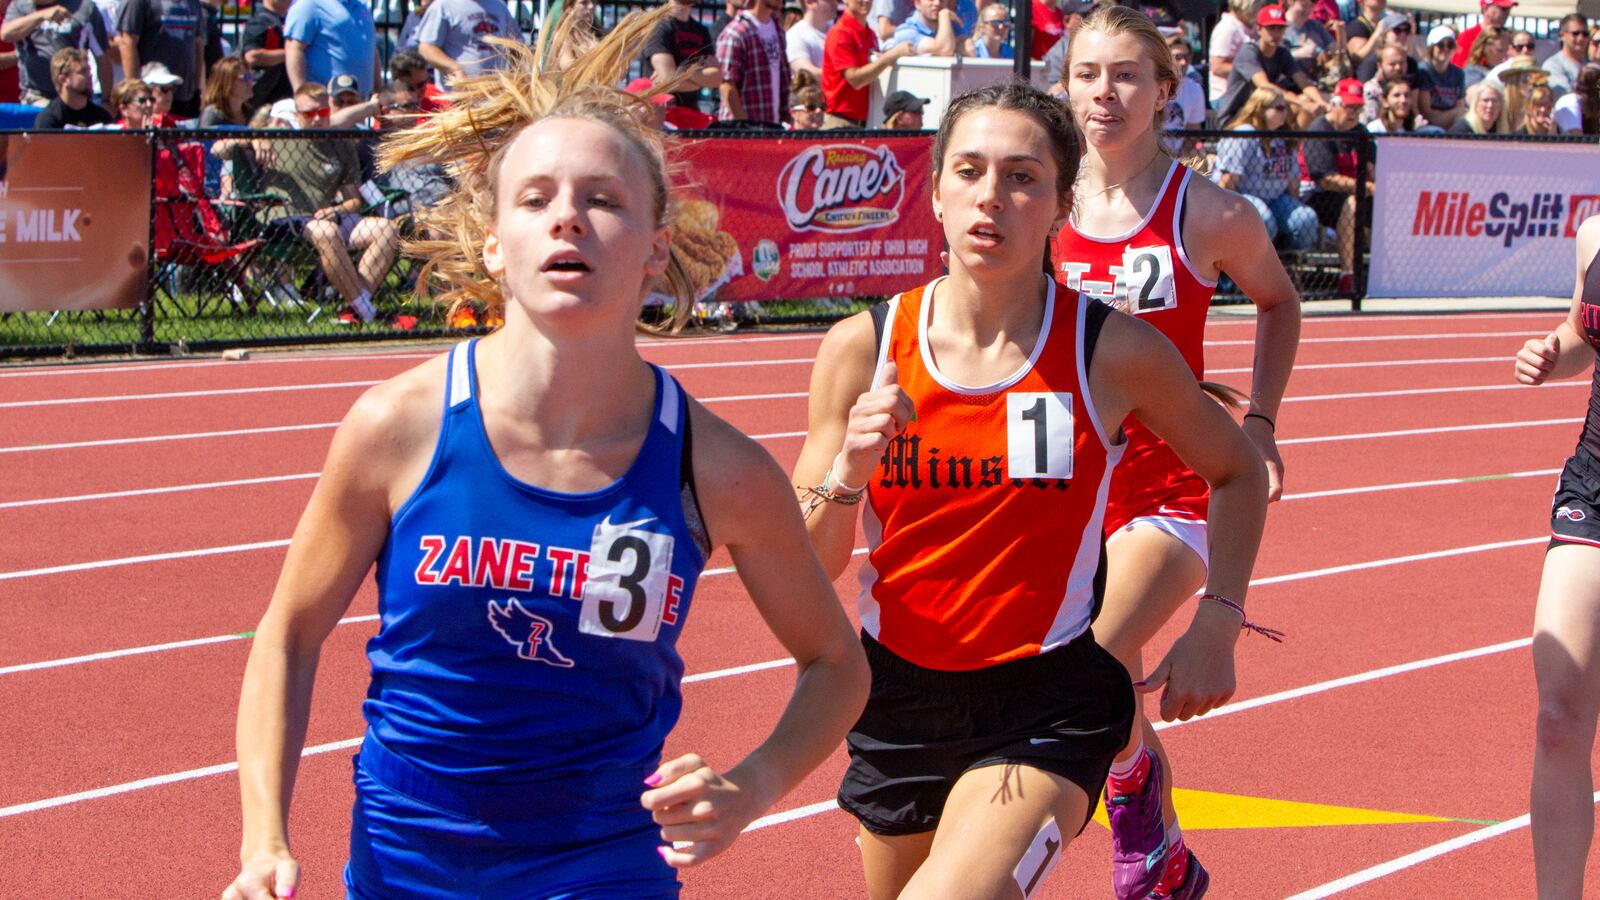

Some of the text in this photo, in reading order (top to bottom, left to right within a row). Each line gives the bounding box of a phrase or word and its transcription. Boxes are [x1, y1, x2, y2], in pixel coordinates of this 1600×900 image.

[785, 147, 903, 226] Cane's
[825, 150, 866, 168] Raising
[16, 209, 81, 243] MILK
[1412, 191, 1563, 247] MileSplit
[789, 239, 928, 258] PROUD SUPPORTER OF OHIO HIGH
[790, 259, 924, 278] SCHOOL ATHLETIC ASSOCIATION
[1133, 253, 1166, 310] 2
[1021, 397, 1048, 474] 1
[414, 535, 539, 592] ZANE
[598, 535, 651, 633] 3
[1024, 836, 1060, 898] 1
